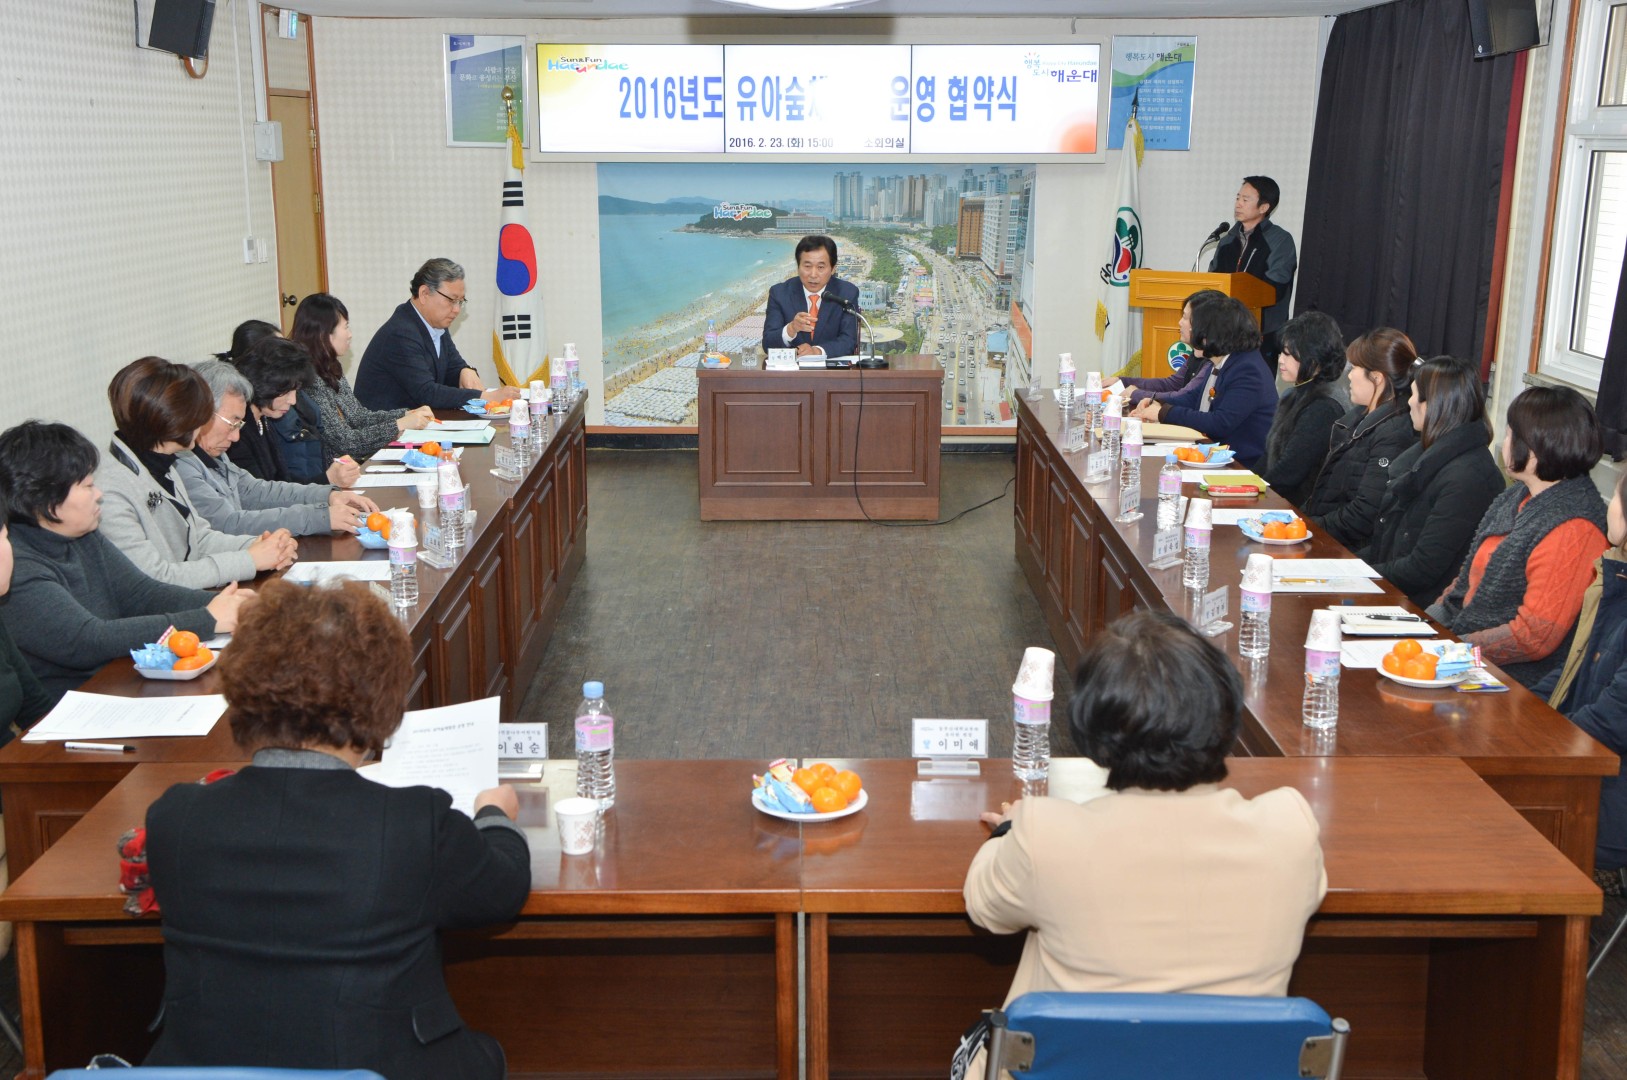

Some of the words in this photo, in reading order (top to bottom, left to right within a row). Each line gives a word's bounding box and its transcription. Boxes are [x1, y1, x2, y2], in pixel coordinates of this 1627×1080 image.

[1050, 69, 1098, 83] 해운대
[619, 75, 724, 120] 2016년도
[736, 75, 829, 121] 유아숲
[890, 75, 936, 122] 운영
[947, 75, 1017, 121] 협약식
[729, 137, 756, 148] 2016.
[758, 137, 767, 148] 2.
[769, 137, 785, 148] 23.
[807, 137, 834, 148] 15:00
